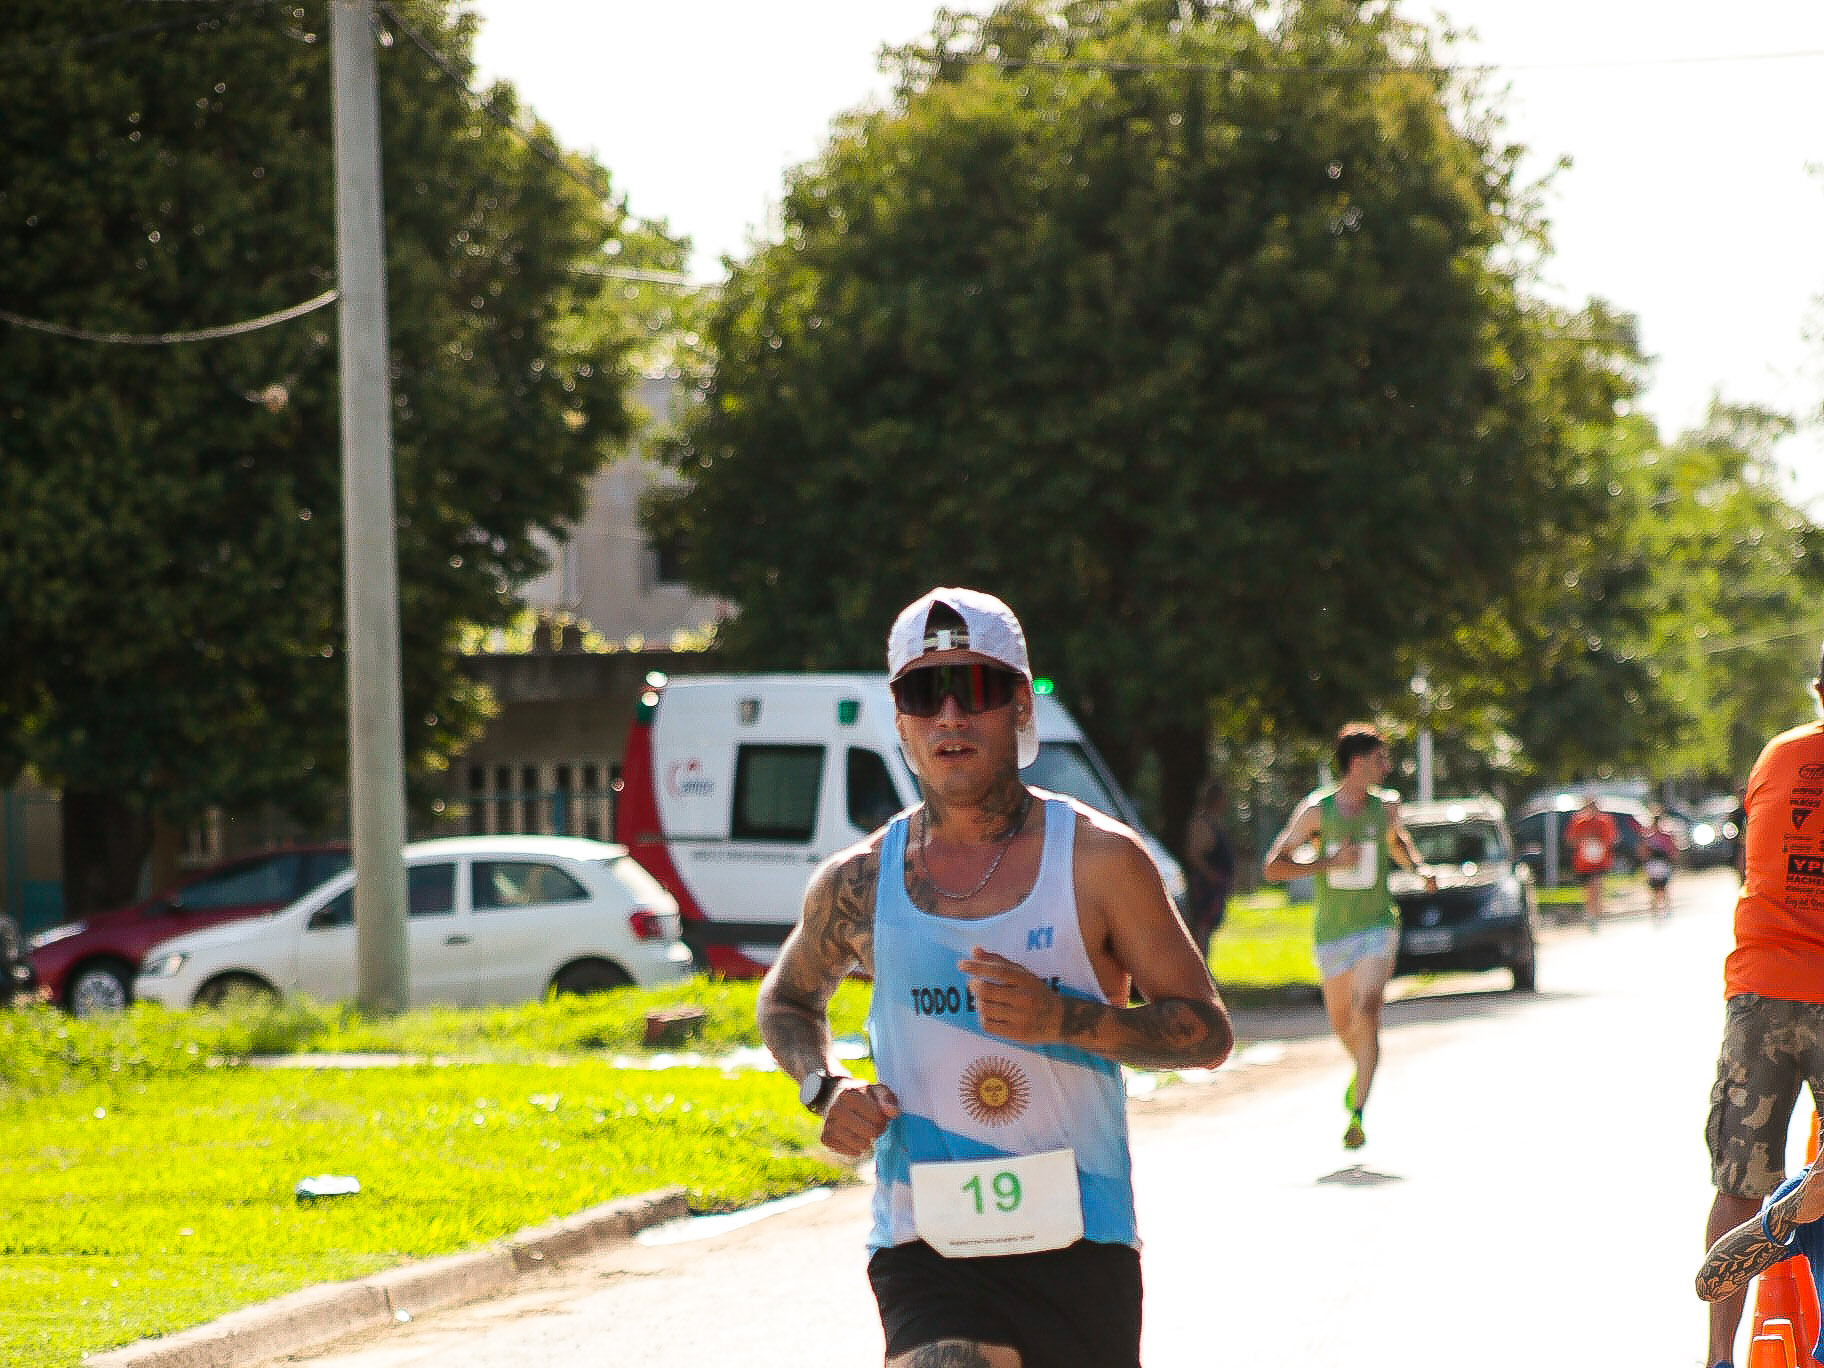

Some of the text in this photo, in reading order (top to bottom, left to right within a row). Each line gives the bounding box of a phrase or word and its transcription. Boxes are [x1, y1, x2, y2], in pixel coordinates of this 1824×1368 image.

[1793, 858, 1824, 873] YP
[911, 986, 961, 1016] TODO
[962, 1172, 1022, 1215] 19
